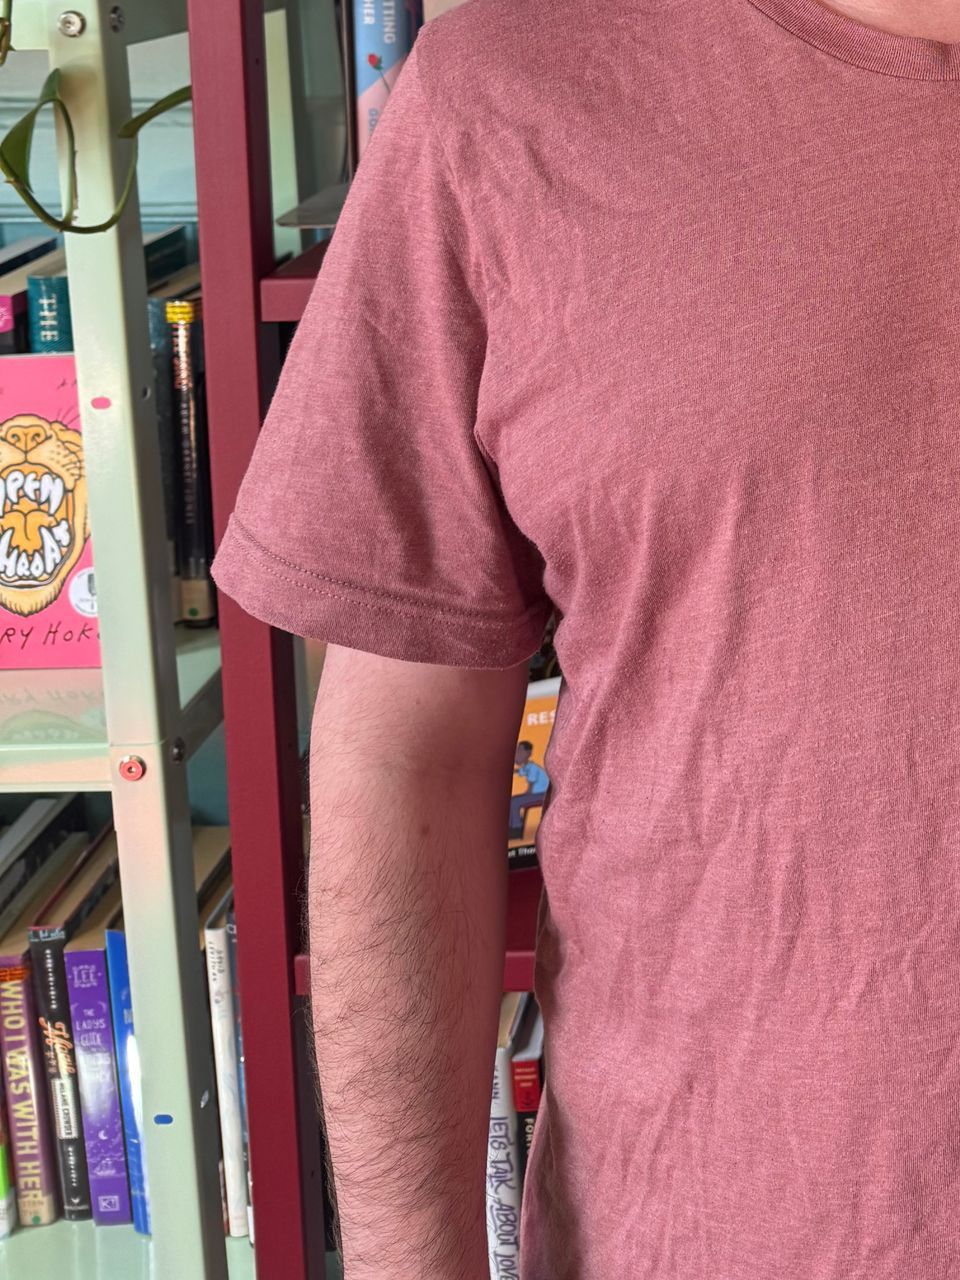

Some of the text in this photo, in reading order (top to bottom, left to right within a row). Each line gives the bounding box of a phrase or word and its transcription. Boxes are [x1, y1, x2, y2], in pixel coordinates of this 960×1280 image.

[40, 297, 58, 342] THE
[43, 622, 100, 644] HOK
[73, 968, 95, 983] LEE
[0, 979, 42, 1203] WHO I WAS WITH HER
[61, 1108, 73, 1137] CROWDER
[490, 1116, 515, 1151] LET'S
[491, 1152, 517, 1193] TALK
[491, 1195, 519, 1251] ABOUT
